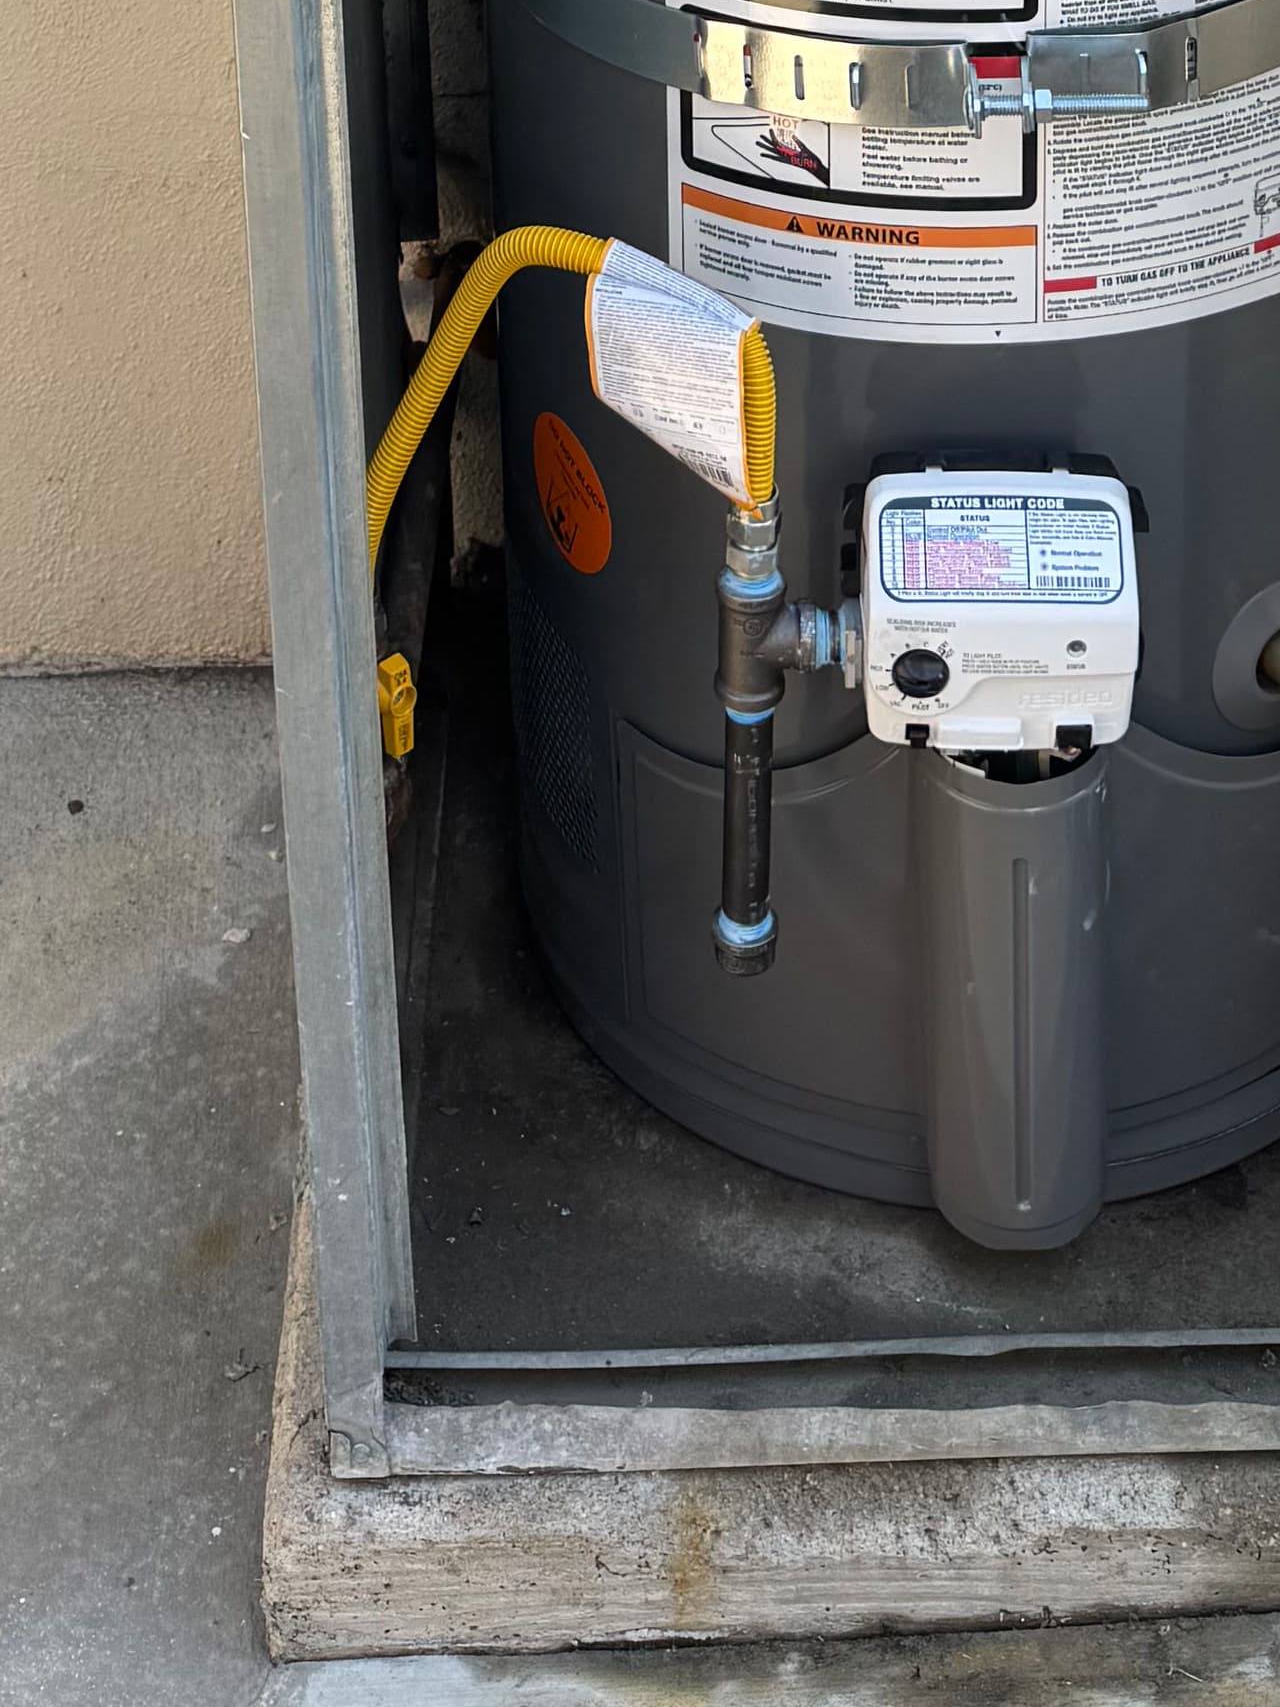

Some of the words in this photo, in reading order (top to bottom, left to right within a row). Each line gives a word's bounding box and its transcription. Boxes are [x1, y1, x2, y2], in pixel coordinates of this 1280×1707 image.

[773, 115, 799, 129] HOT
[878, 128, 919, 137] instruction
[921, 130, 949, 138] manual
[890, 137, 935, 147] temperature
[862, 152, 878, 160] Feel
[880, 154, 900, 162] water
[929, 156, 958, 165] bathing
[862, 171, 909, 181] Temperature
[911, 174, 940, 184] limiting
[816, 222, 920, 245] WARNING
[1101, 277, 1113, 287] TO
[1115, 274, 1138, 286] TURN
[1140, 270, 1158, 282] GAS
[1159, 267, 1175, 278] OFF
[1177, 264, 1188, 274] TO
[1190, 260, 1206, 272] THE
[1208, 247, 1251, 267] APPLIANCE
[931, 498, 981, 509] STATUS
[984, 498, 1023, 509] LIGHT
[1027, 498, 1065, 509] CODE
